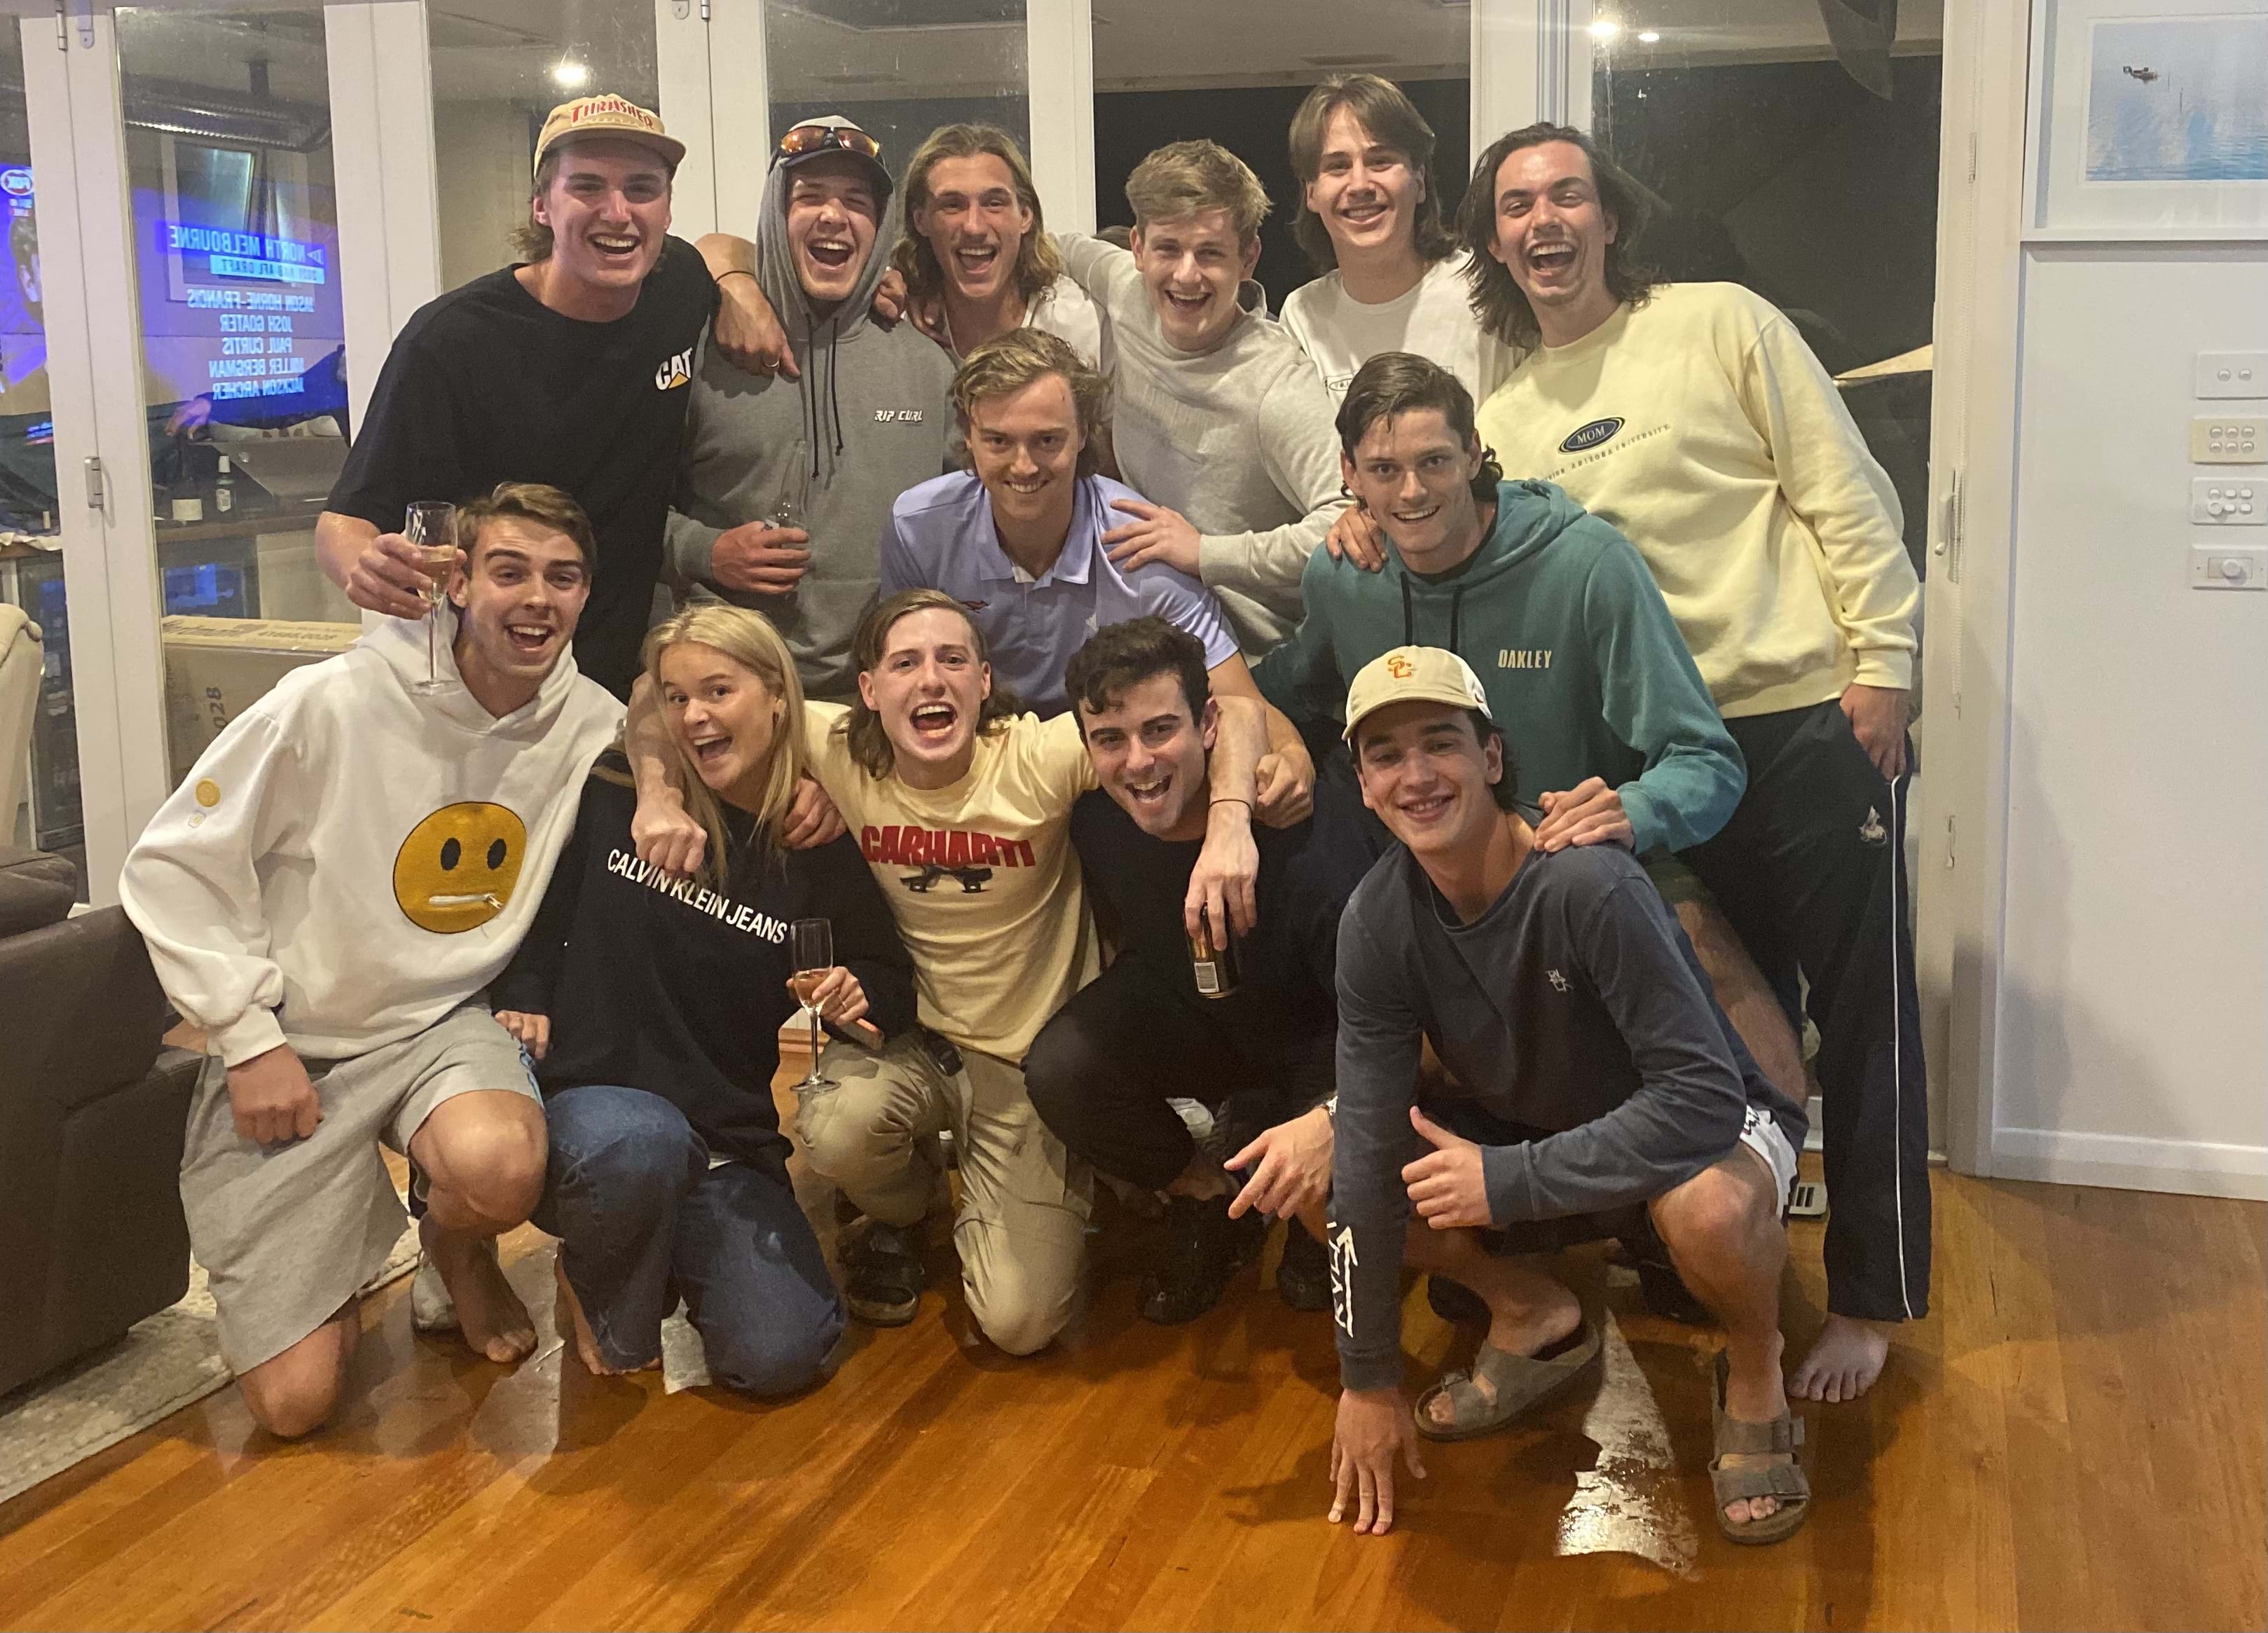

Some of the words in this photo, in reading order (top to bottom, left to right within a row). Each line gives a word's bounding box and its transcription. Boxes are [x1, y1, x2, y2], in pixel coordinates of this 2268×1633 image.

[572, 100, 654, 130] THRASHER
[655, 347, 693, 390] CAT
[874, 410, 895, 422] RIP
[898, 409, 923, 422] CURL
[1577, 425, 1605, 445] MOM
[1498, 649, 1552, 669] OAKLEY
[607, 848, 671, 893] CALVIN
[669, 877, 730, 920] KLEIN
[726, 904, 788, 944] JEANS
